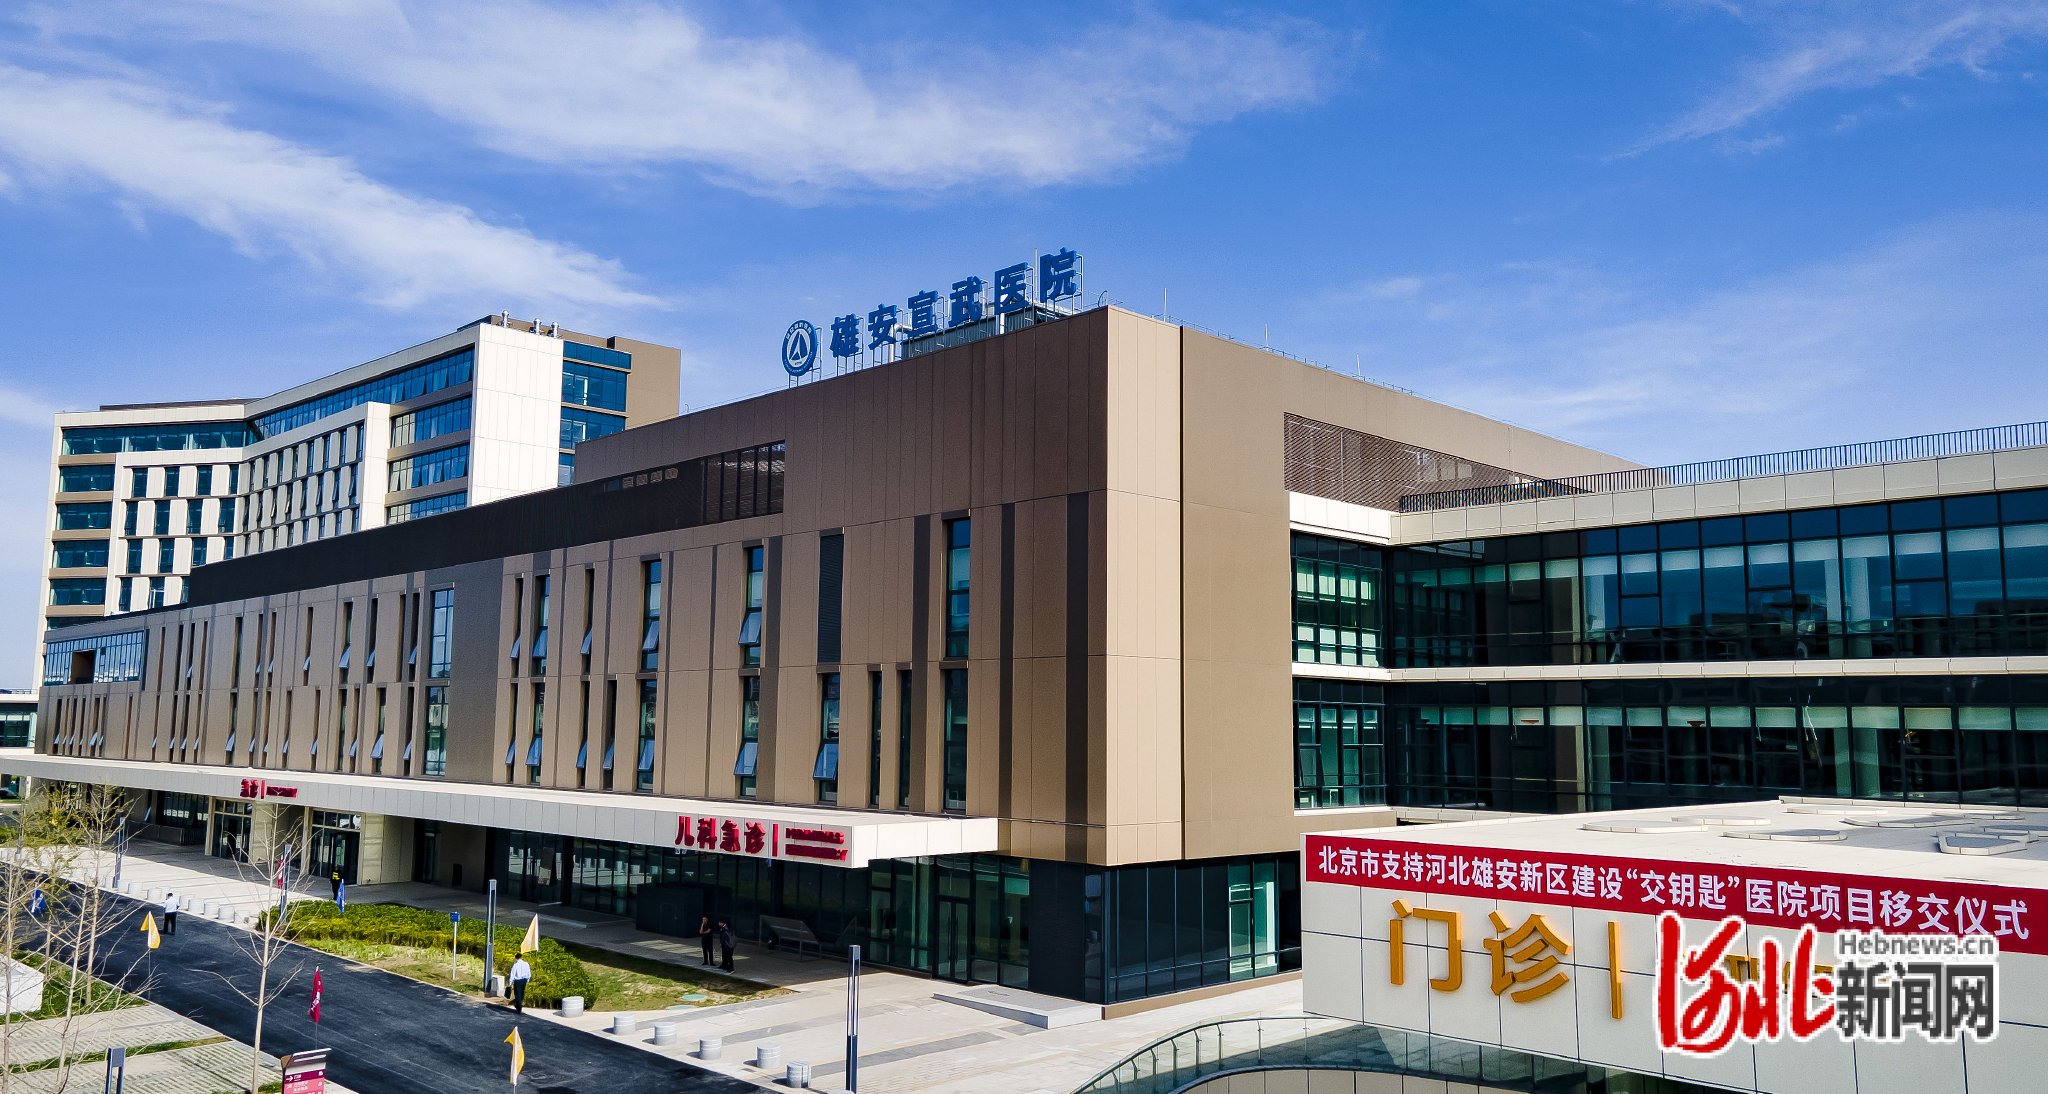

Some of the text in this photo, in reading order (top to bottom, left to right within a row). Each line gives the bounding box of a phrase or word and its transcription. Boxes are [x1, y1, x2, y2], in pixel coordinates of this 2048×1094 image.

[829, 247, 1078, 358] 雄安宣武医院
[674, 815, 767, 855] 儿科急诊
[1317, 845, 2030, 941] 北京市支持河北雄安新区建设“交钥匙”医院项目移交仪式
[1389, 898, 1573, 1004] 门诊
